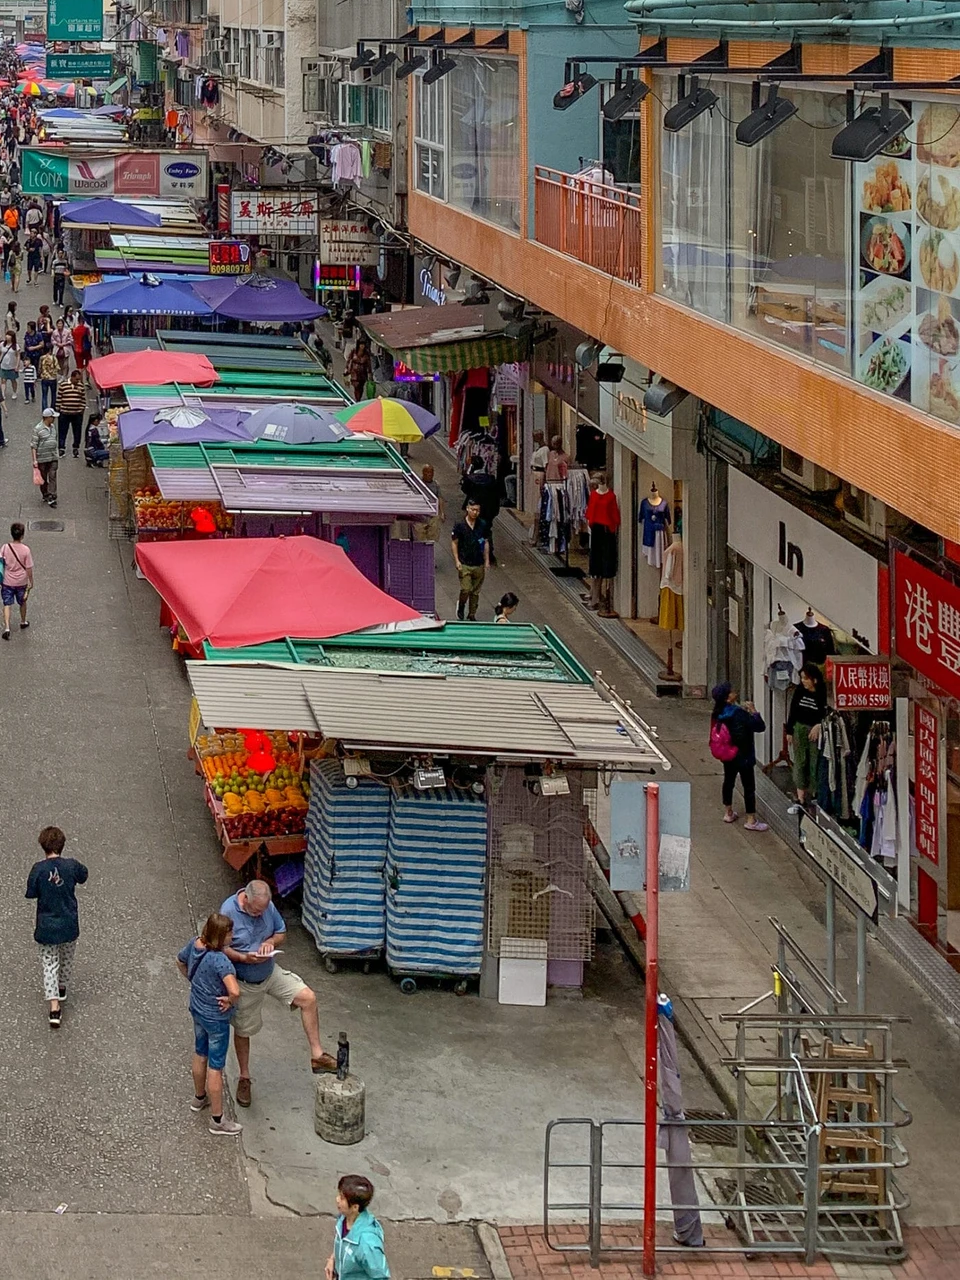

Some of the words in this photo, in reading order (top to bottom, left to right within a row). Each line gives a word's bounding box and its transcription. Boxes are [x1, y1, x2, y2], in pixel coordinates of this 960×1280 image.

[122, 170, 152, 181] Triumph
[211, 264, 250, 274] 60980978
[837, 667, 889, 689] 人民幣找換
[847, 693, 868, 706] 2886
[869, 693, 889, 706] 5599
